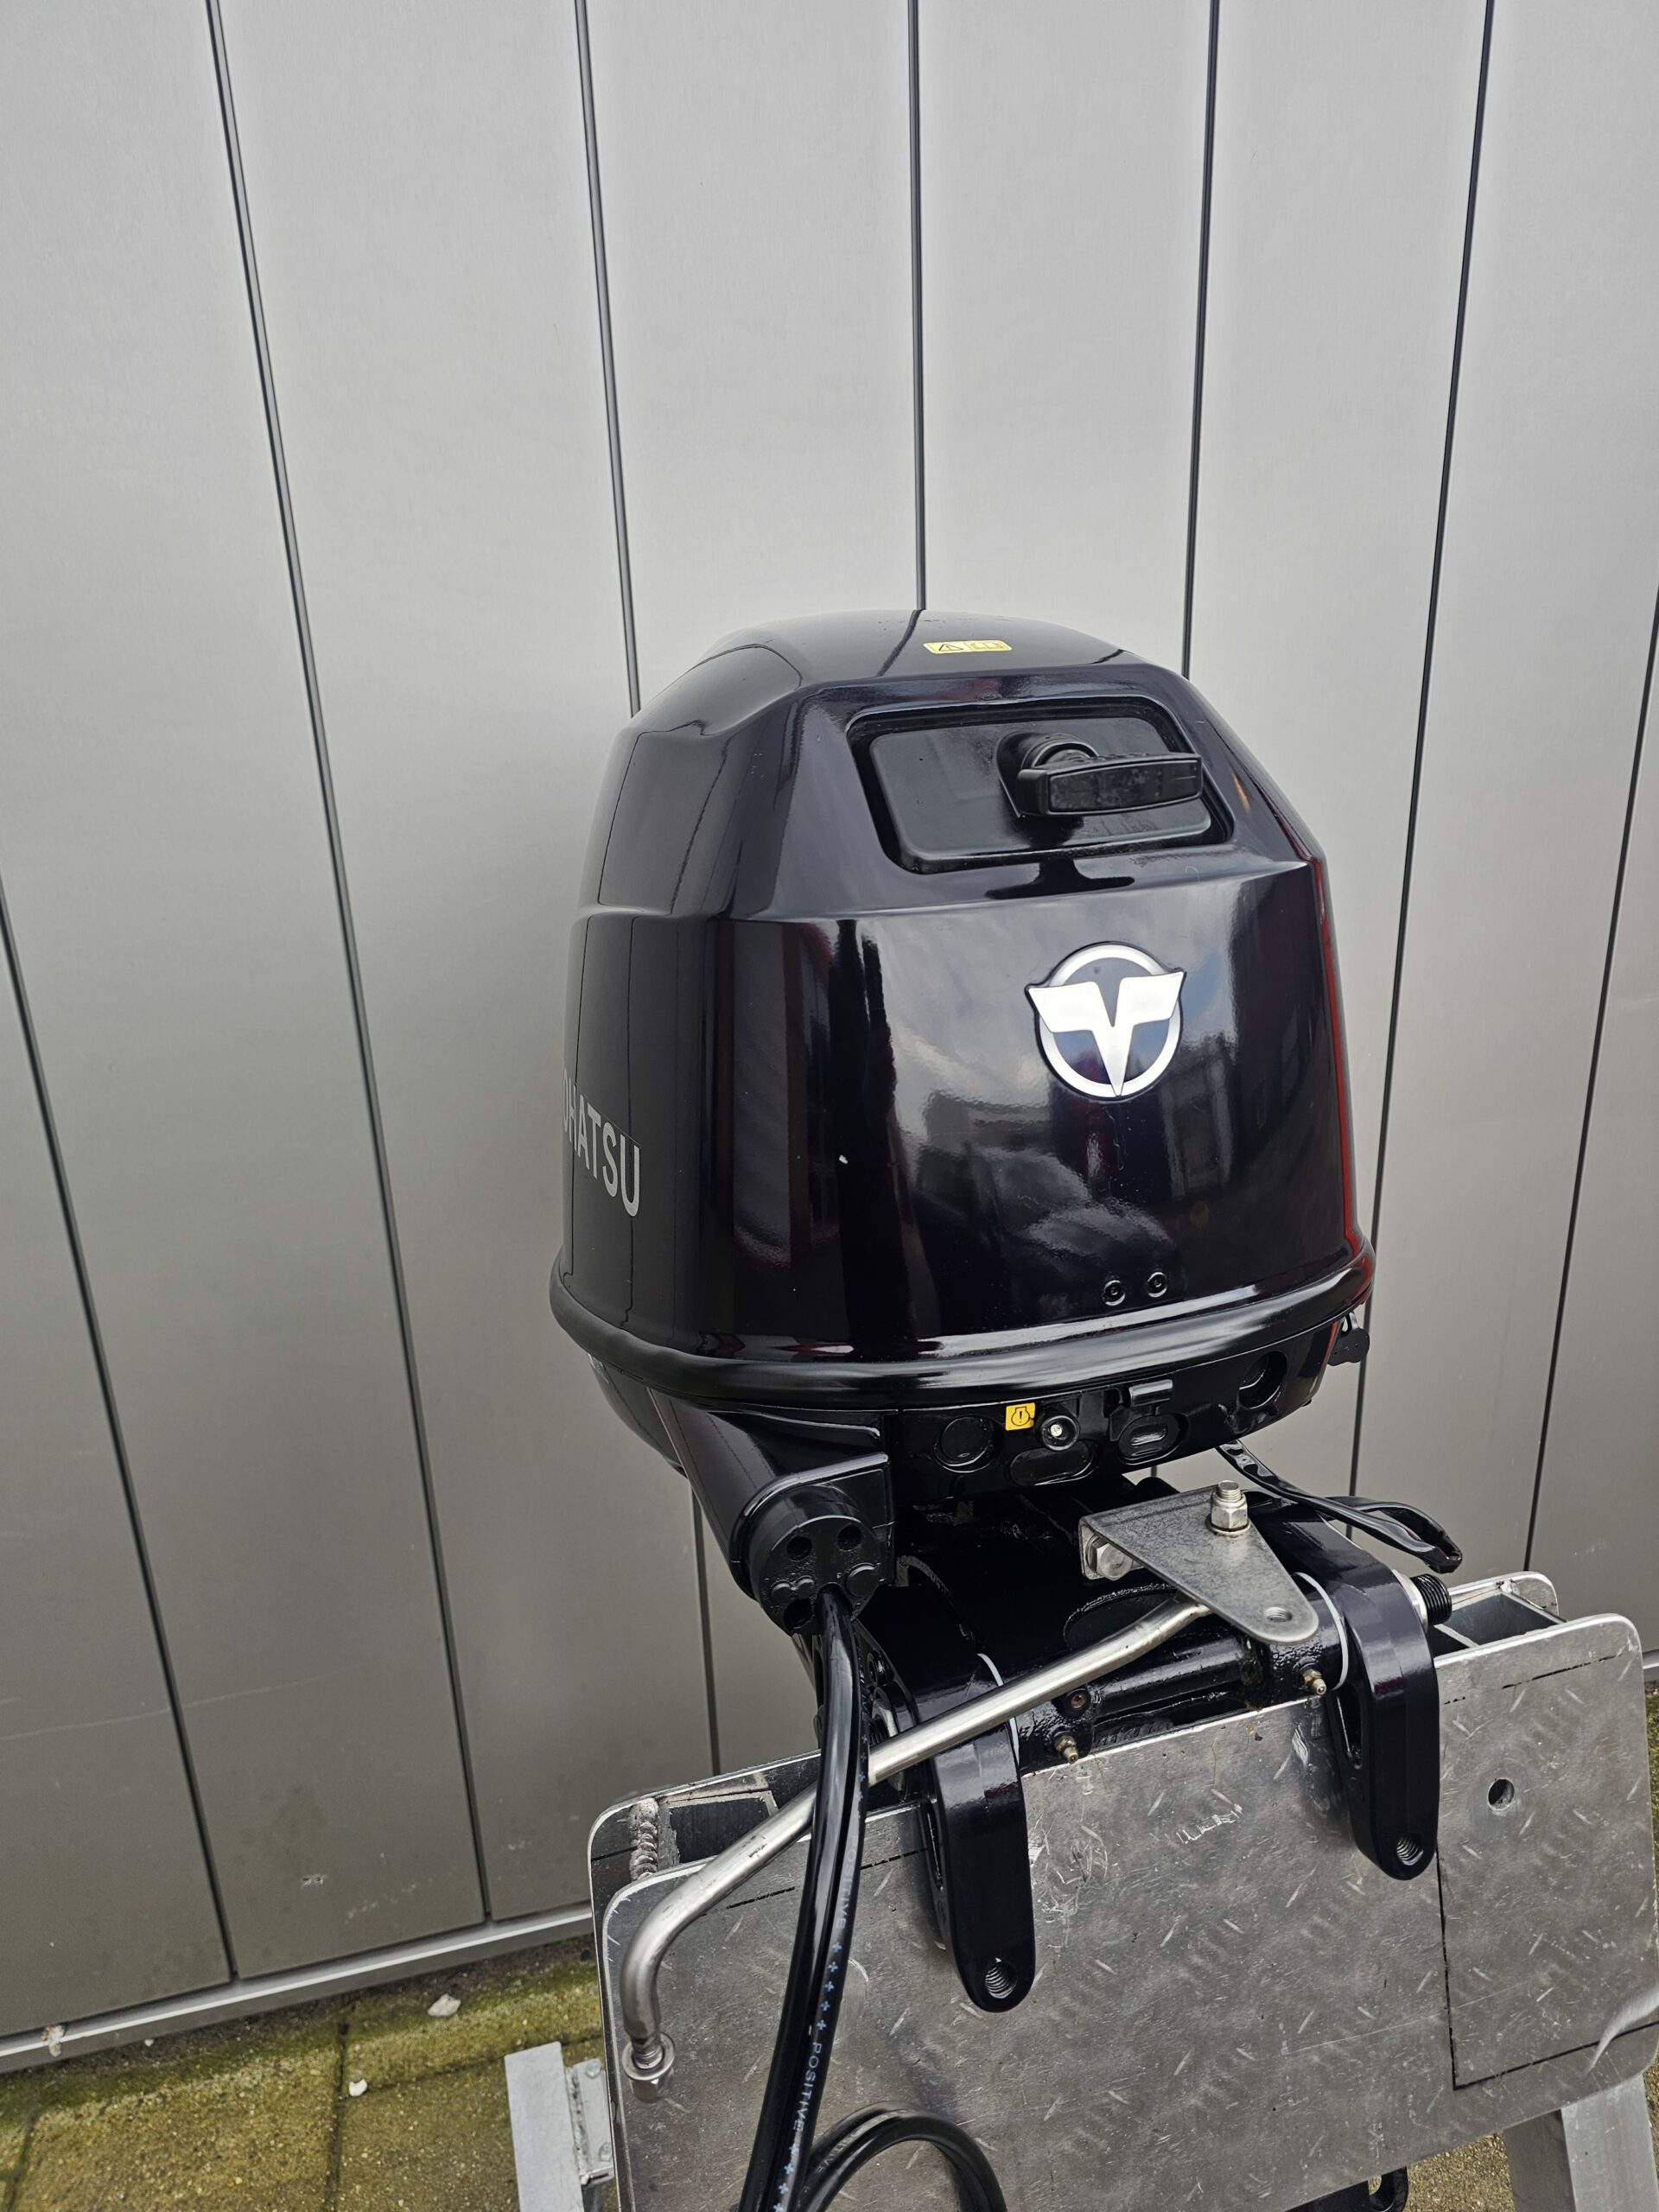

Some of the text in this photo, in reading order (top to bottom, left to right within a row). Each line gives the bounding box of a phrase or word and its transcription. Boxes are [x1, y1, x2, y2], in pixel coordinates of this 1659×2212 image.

[836, 1834, 858, 1929] POSITIVE
[793, 2042, 823, 2132] POSITIVE
[817, 2121, 869, 2173] SITIVE
